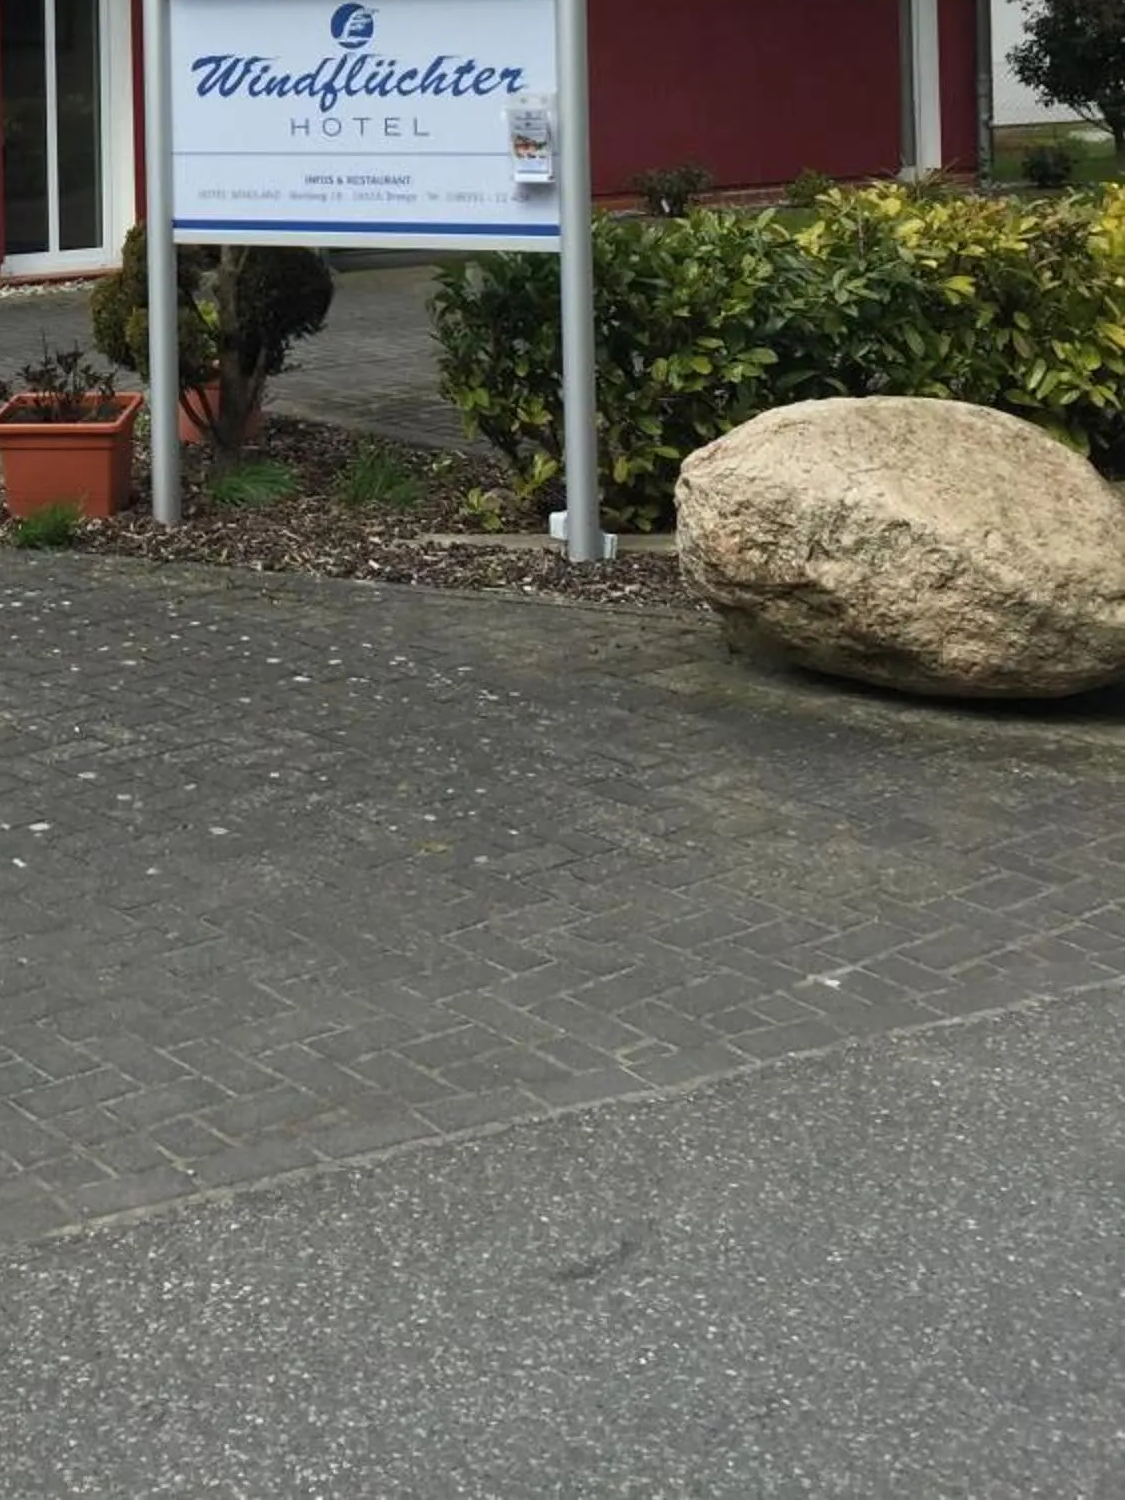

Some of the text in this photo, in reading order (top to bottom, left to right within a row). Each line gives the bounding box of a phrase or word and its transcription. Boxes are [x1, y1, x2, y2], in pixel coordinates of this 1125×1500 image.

[191, 53, 527, 112] Windflüchter
[290, 116, 430, 137] HOTEL
[346, 175, 411, 186] RESTAURANT
